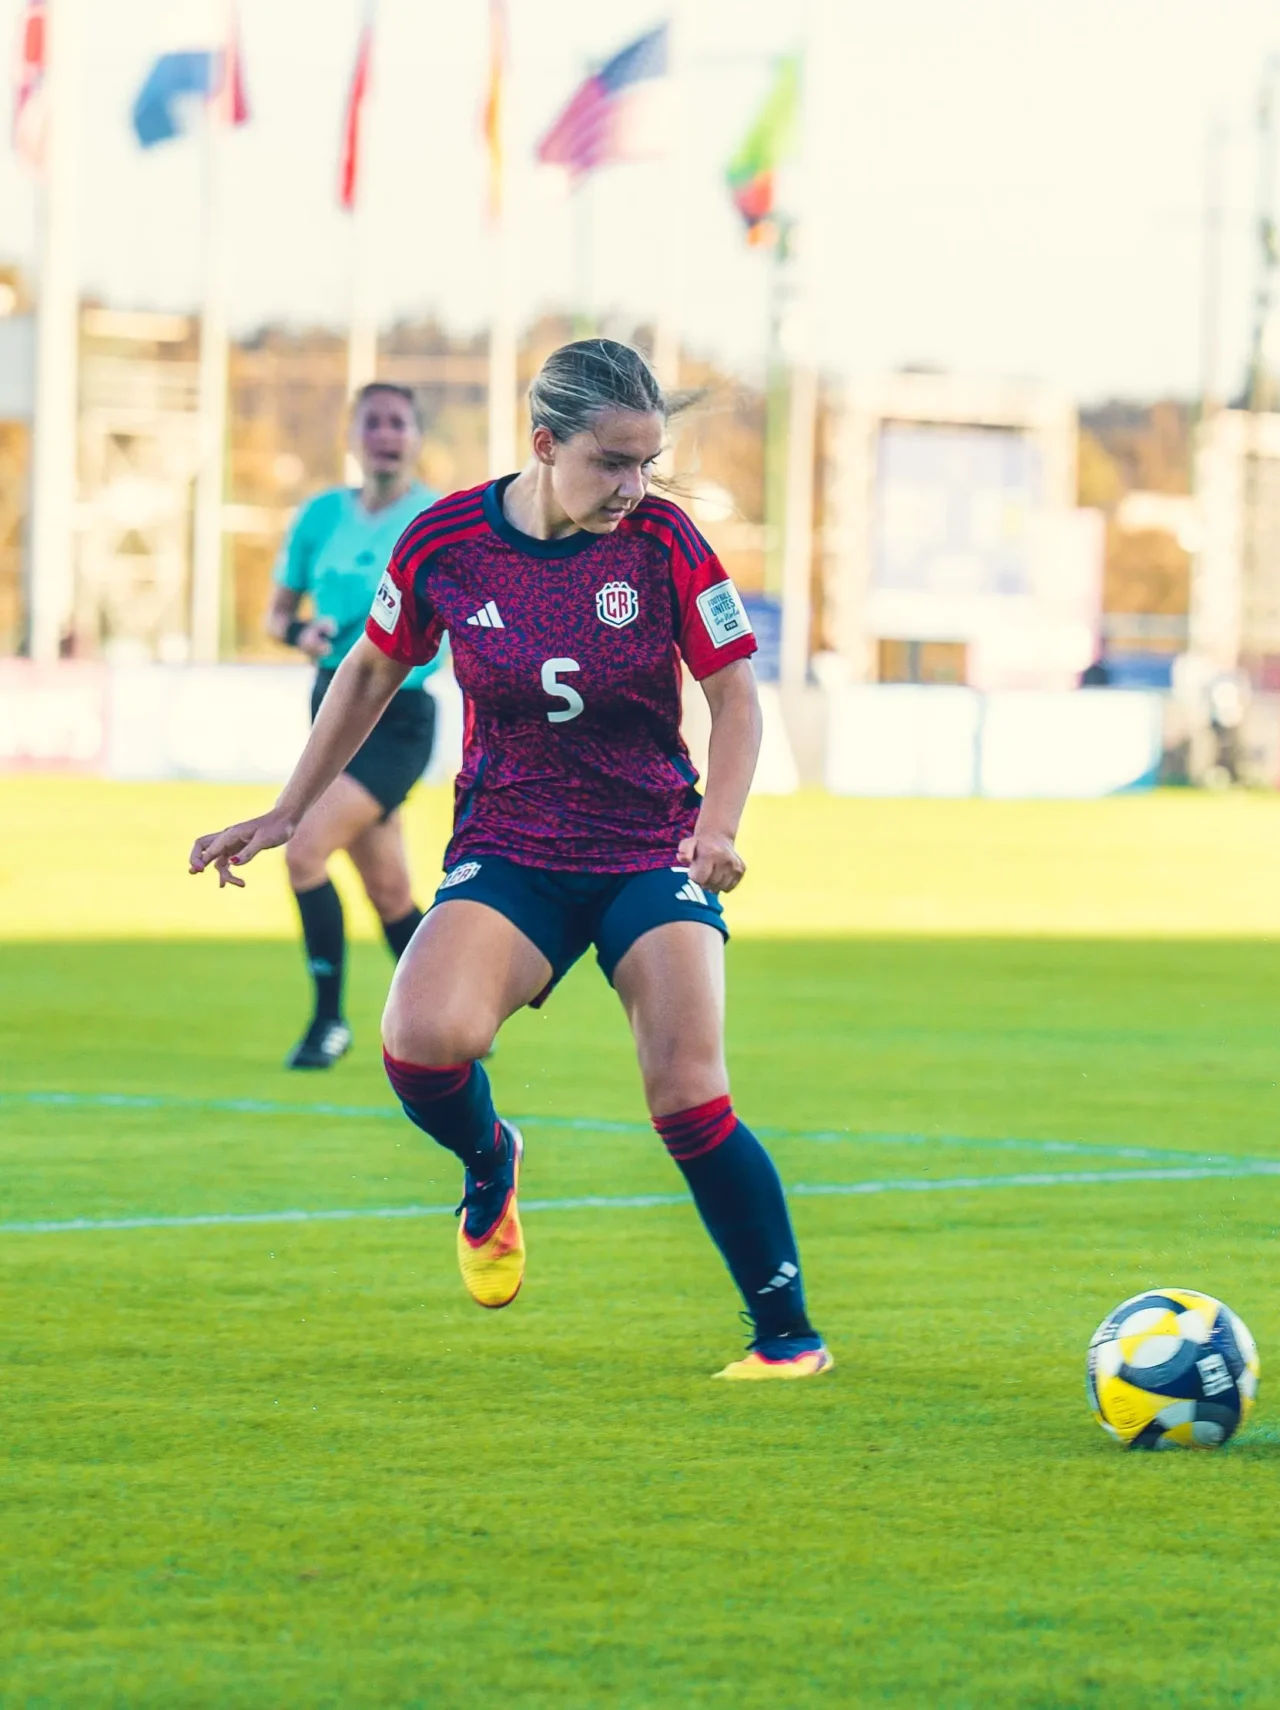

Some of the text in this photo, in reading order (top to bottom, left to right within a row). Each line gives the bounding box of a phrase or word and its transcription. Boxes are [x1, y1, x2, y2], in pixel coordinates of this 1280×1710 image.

[606, 591, 629, 619] CR
[710, 598, 736, 617] UNITES
[541, 657, 585, 723] 5
